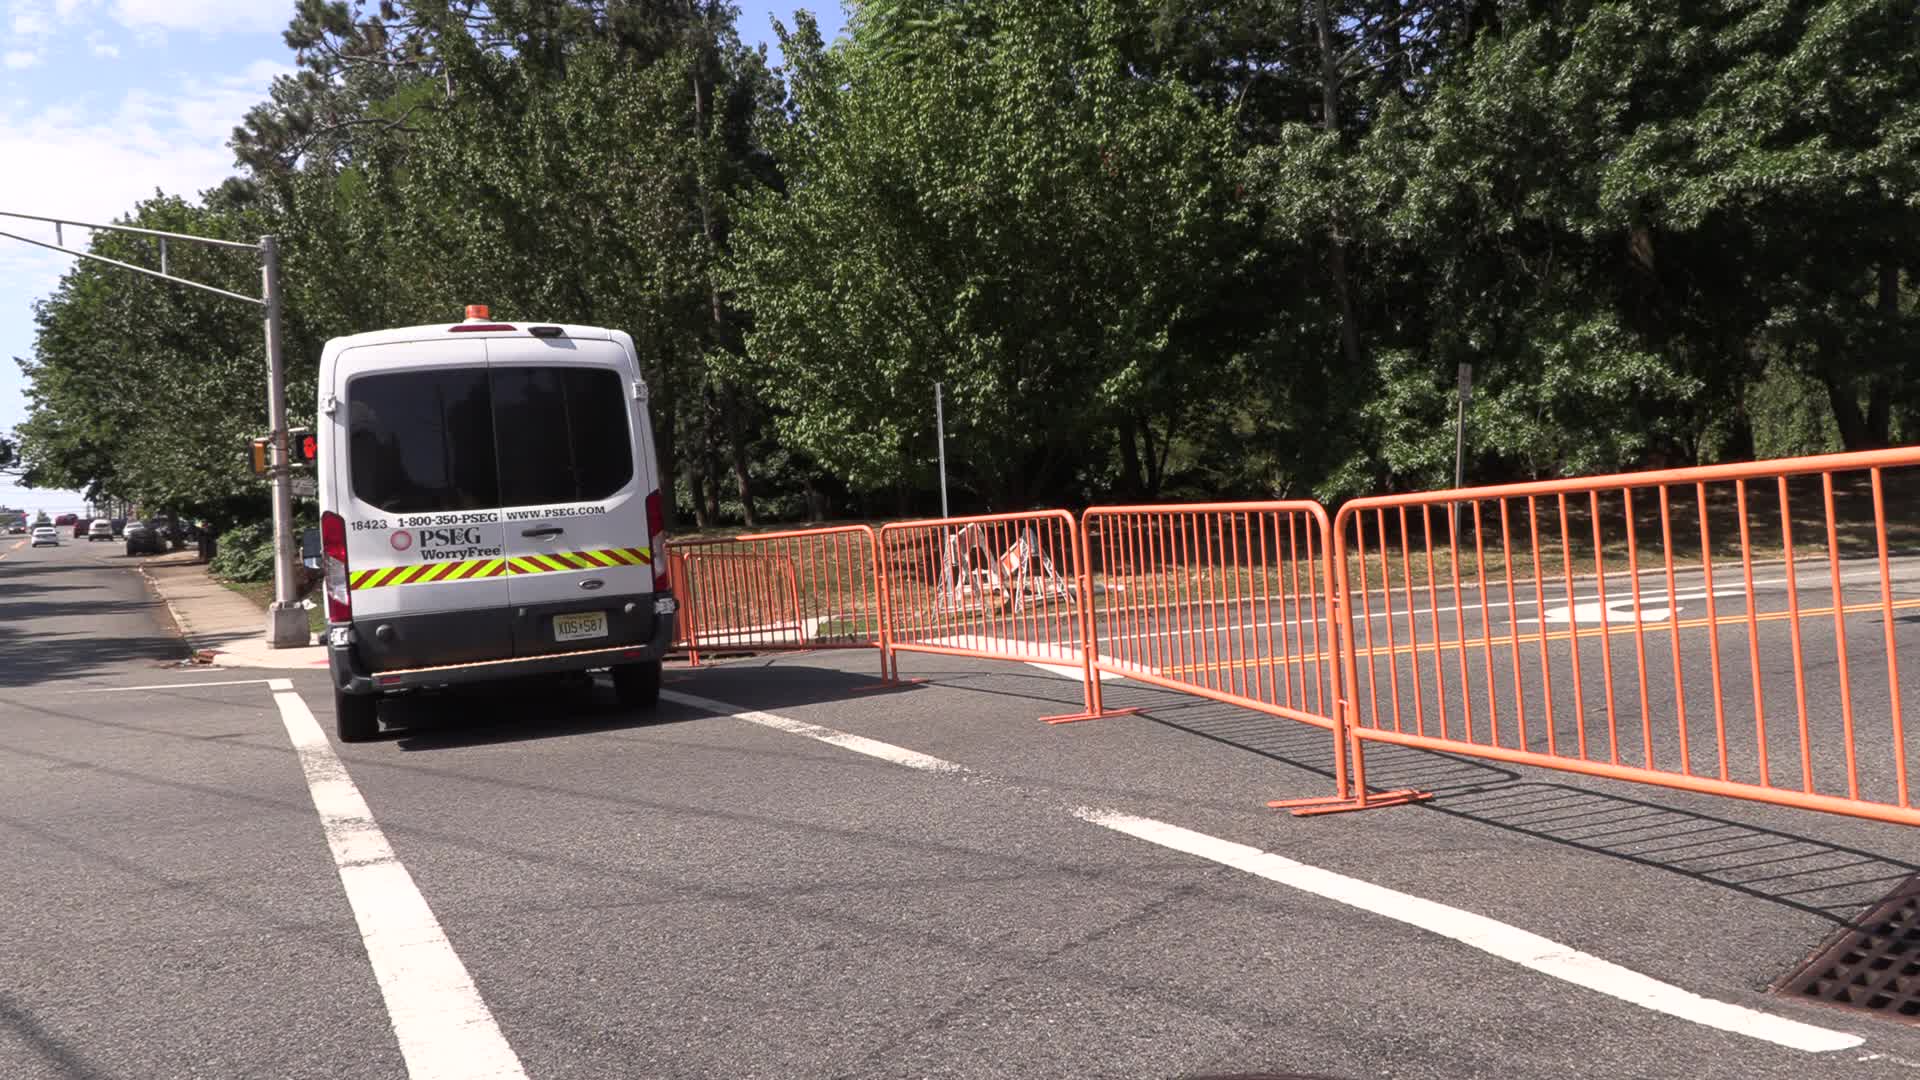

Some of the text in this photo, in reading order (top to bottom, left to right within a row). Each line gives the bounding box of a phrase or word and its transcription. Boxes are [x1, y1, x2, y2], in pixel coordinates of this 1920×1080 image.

[398, 513, 498, 527] 1-800-350-PSEG
[506, 506, 606, 520] WWW.PSEG.COM
[351, 519, 388, 531] 18423
[420, 545, 501, 561] WorryFree
